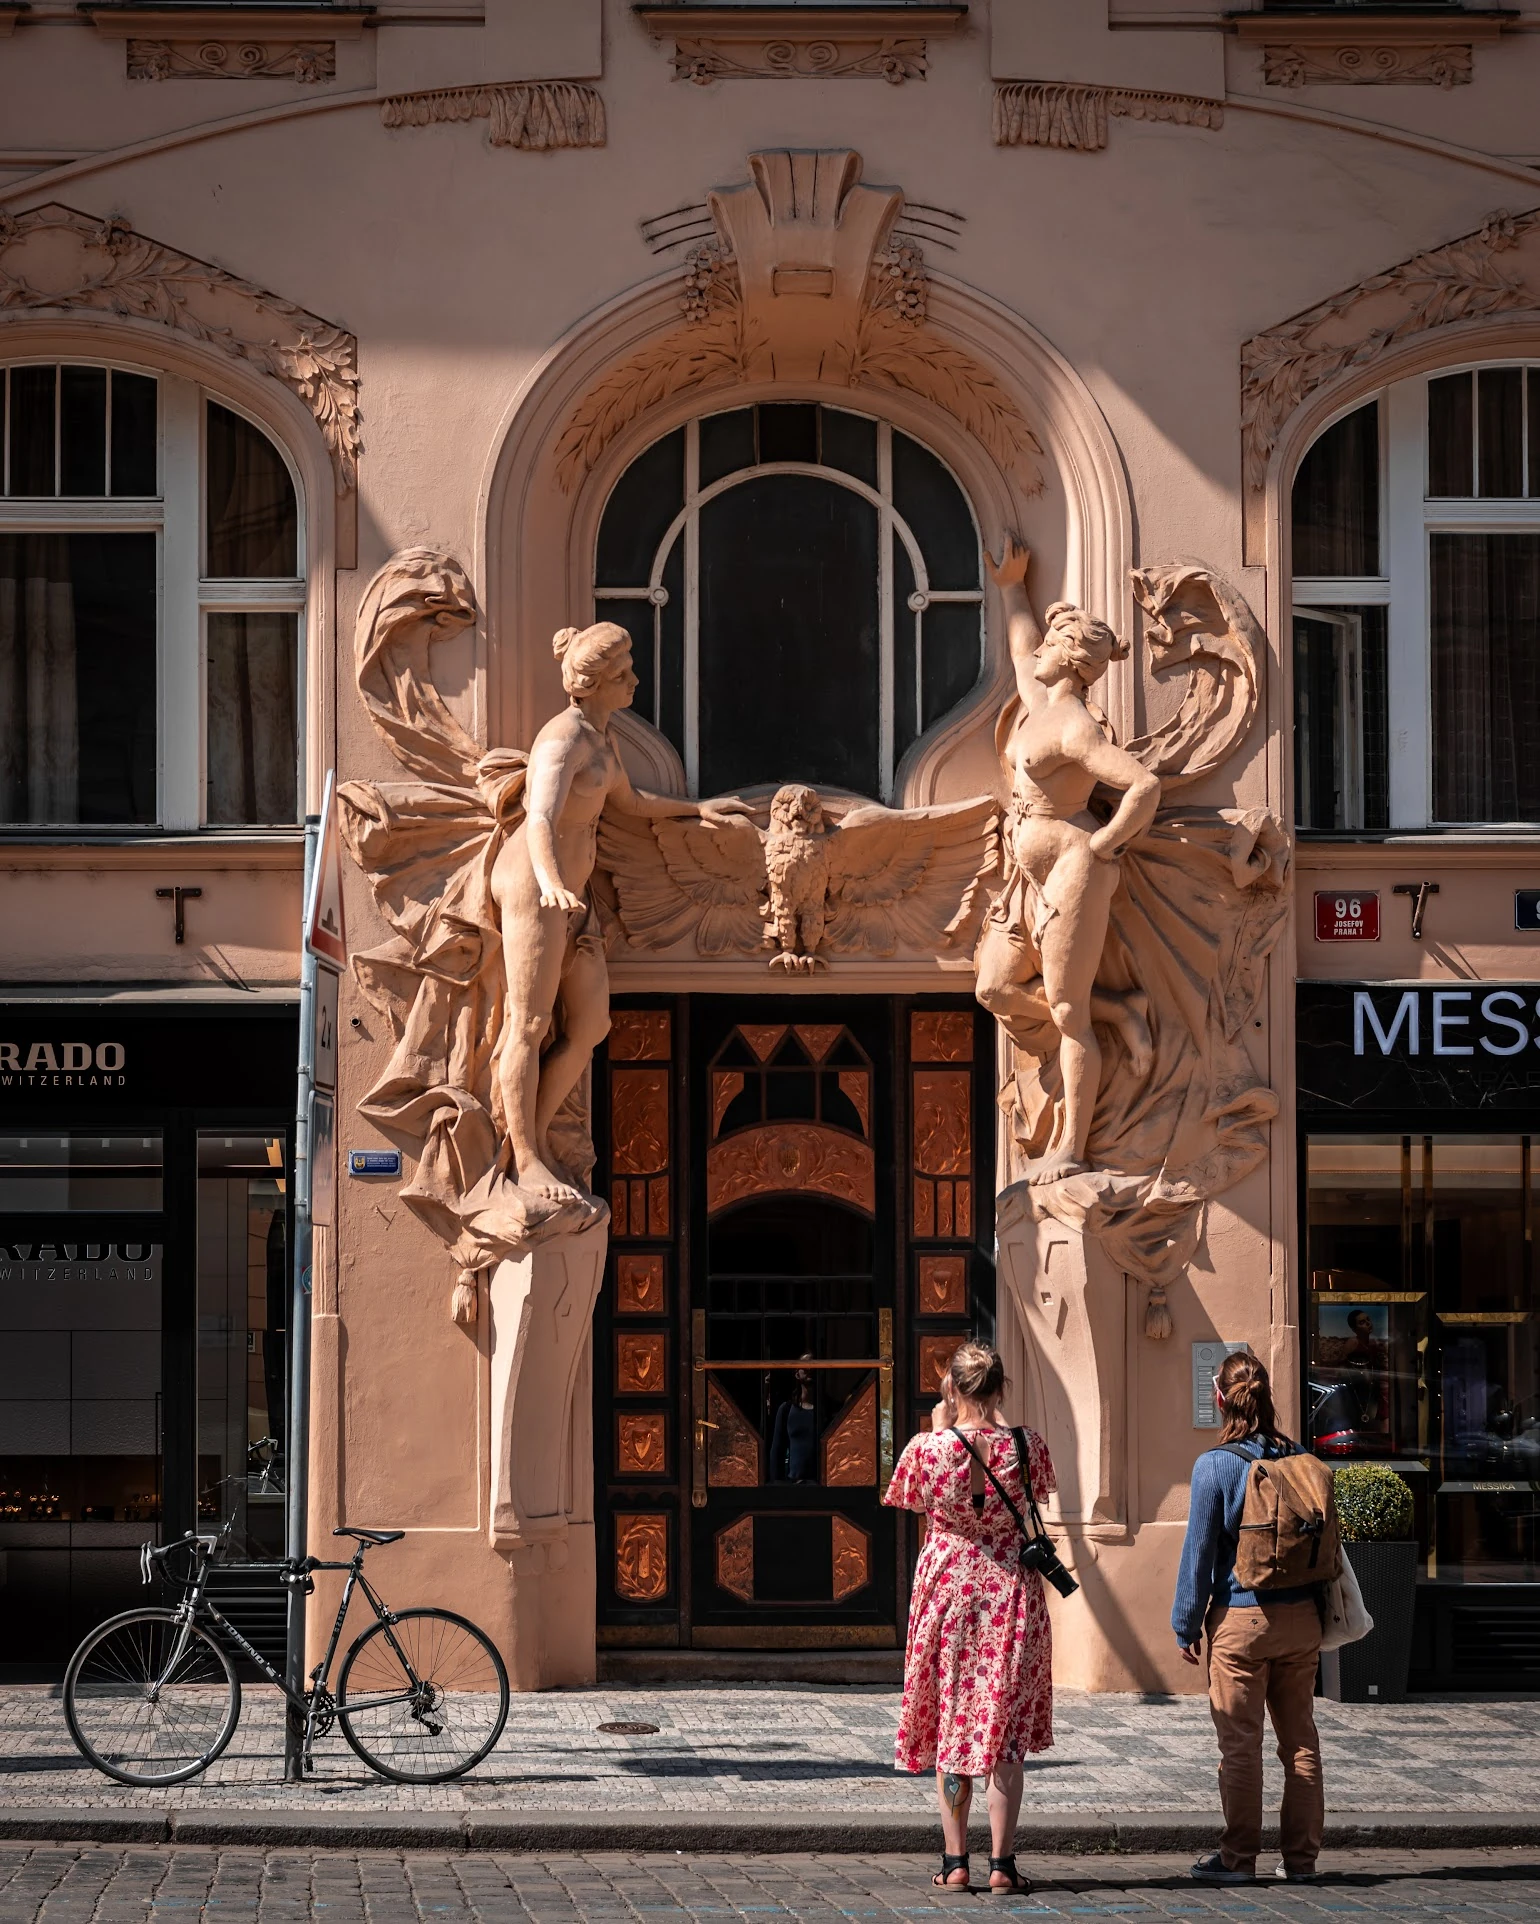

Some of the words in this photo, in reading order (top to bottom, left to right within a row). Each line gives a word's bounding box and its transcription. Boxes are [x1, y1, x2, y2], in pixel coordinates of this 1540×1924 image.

[1335, 898, 1362, 919] 96
[1333, 928, 1357, 936] PRAHA
[1358, 928, 1363, 936] 1
[1334, 920, 1364, 928] JOSEFOV
[320, 1004, 332, 1051] 2x
[1354, 991, 1540, 1056] MES
[0, 1042, 126, 1071] RADO
[1472, 1482, 1516, 1491] MESSIKA
